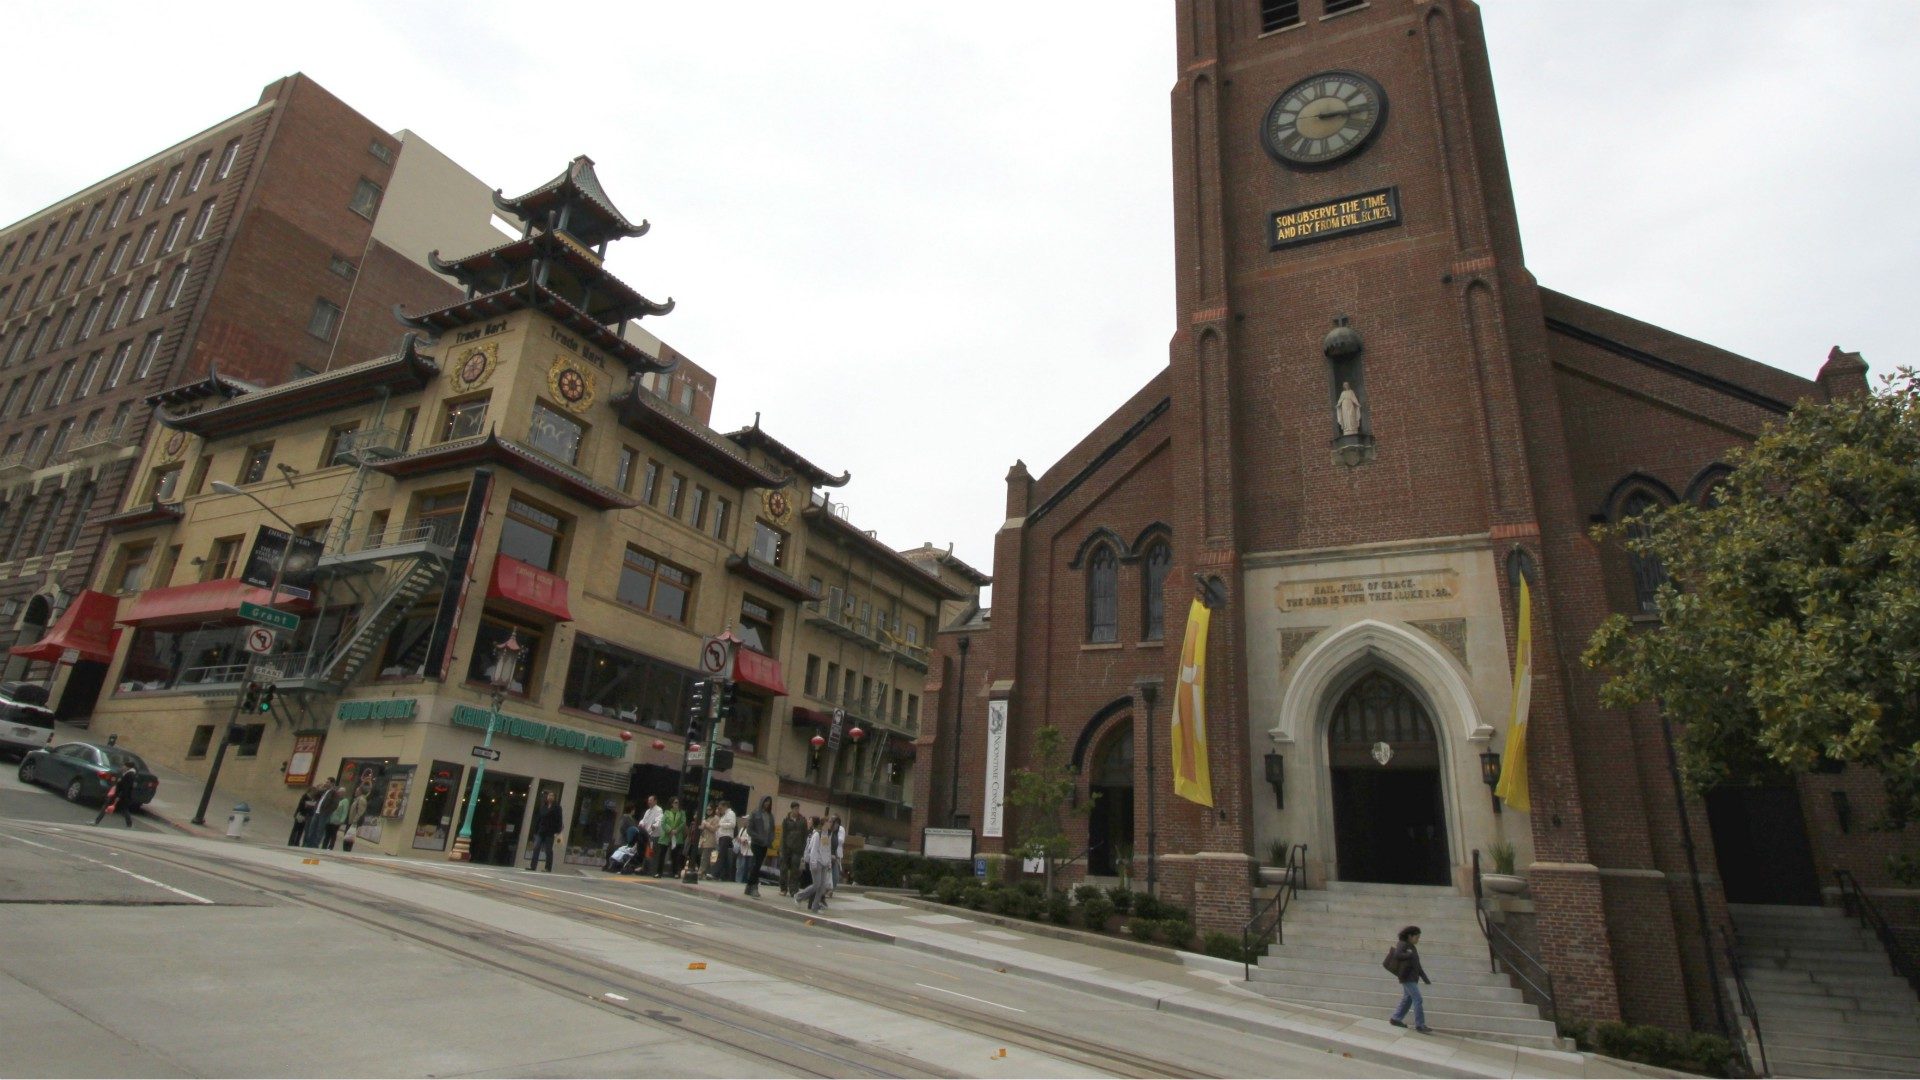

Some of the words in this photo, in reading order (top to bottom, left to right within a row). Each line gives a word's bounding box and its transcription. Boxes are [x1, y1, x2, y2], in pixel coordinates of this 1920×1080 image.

[1297, 204, 1337, 223] OBSERVE
[1340, 200, 1360, 213] THE
[1362, 194, 1387, 209] TIME
[1278, 226, 1296, 240] AND
[1298, 222, 1313, 235] FLY
[1315, 217, 1340, 232] FROM
[456, 328, 481, 344] Trade
[551, 325, 578, 351] Trade
[1341, 583, 1364, 593] FULL
[1368, 581, 1378, 590] OF
[1286, 598, 1303, 607] THE
[1305, 596, 1328, 606] LORD
[1330, 595, 1339, 604] IS
[1340, 593, 1365, 603] WITH
[252, 607, 287, 625] Grant
[256, 667, 282, 678] GRANT
[336, 701, 370, 720] FOOD
[370, 699, 416, 720] COURT
[453, 704, 549, 741] CHINATOWN
[548, 725, 586, 751] FOOD
[586, 734, 628, 759] COURT
[990, 781, 1000, 826] CONCERTS
